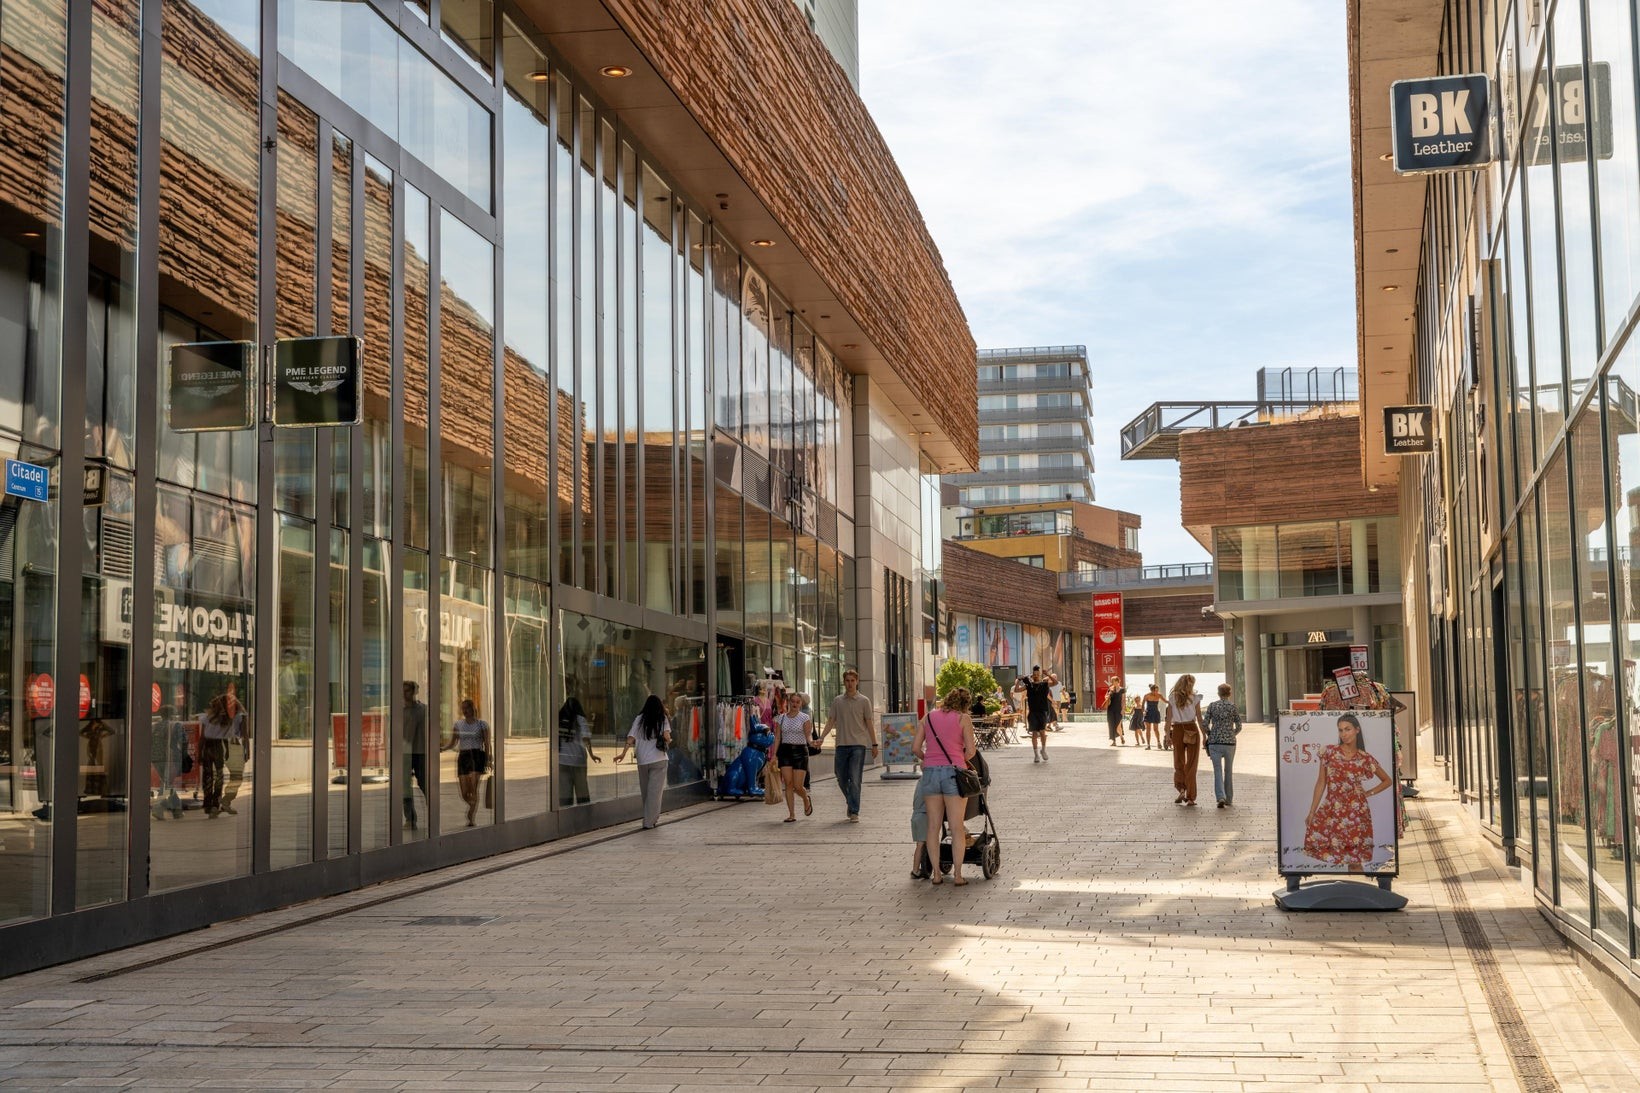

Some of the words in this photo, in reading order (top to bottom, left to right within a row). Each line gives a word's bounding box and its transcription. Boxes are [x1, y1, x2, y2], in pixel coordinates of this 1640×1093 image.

[1409, 89, 1473, 138] BK
[1413, 140, 1473, 156] Leather
[285, 367, 307, 376] PME
[308, 366, 347, 375] LEGEND
[1391, 412, 1425, 437] BK
[1393, 439, 1425, 447] Leather
[11, 463, 44, 483] Citadel
[1307, 631, 1327, 643] ZARA
[1283, 735, 1295, 743] nu
